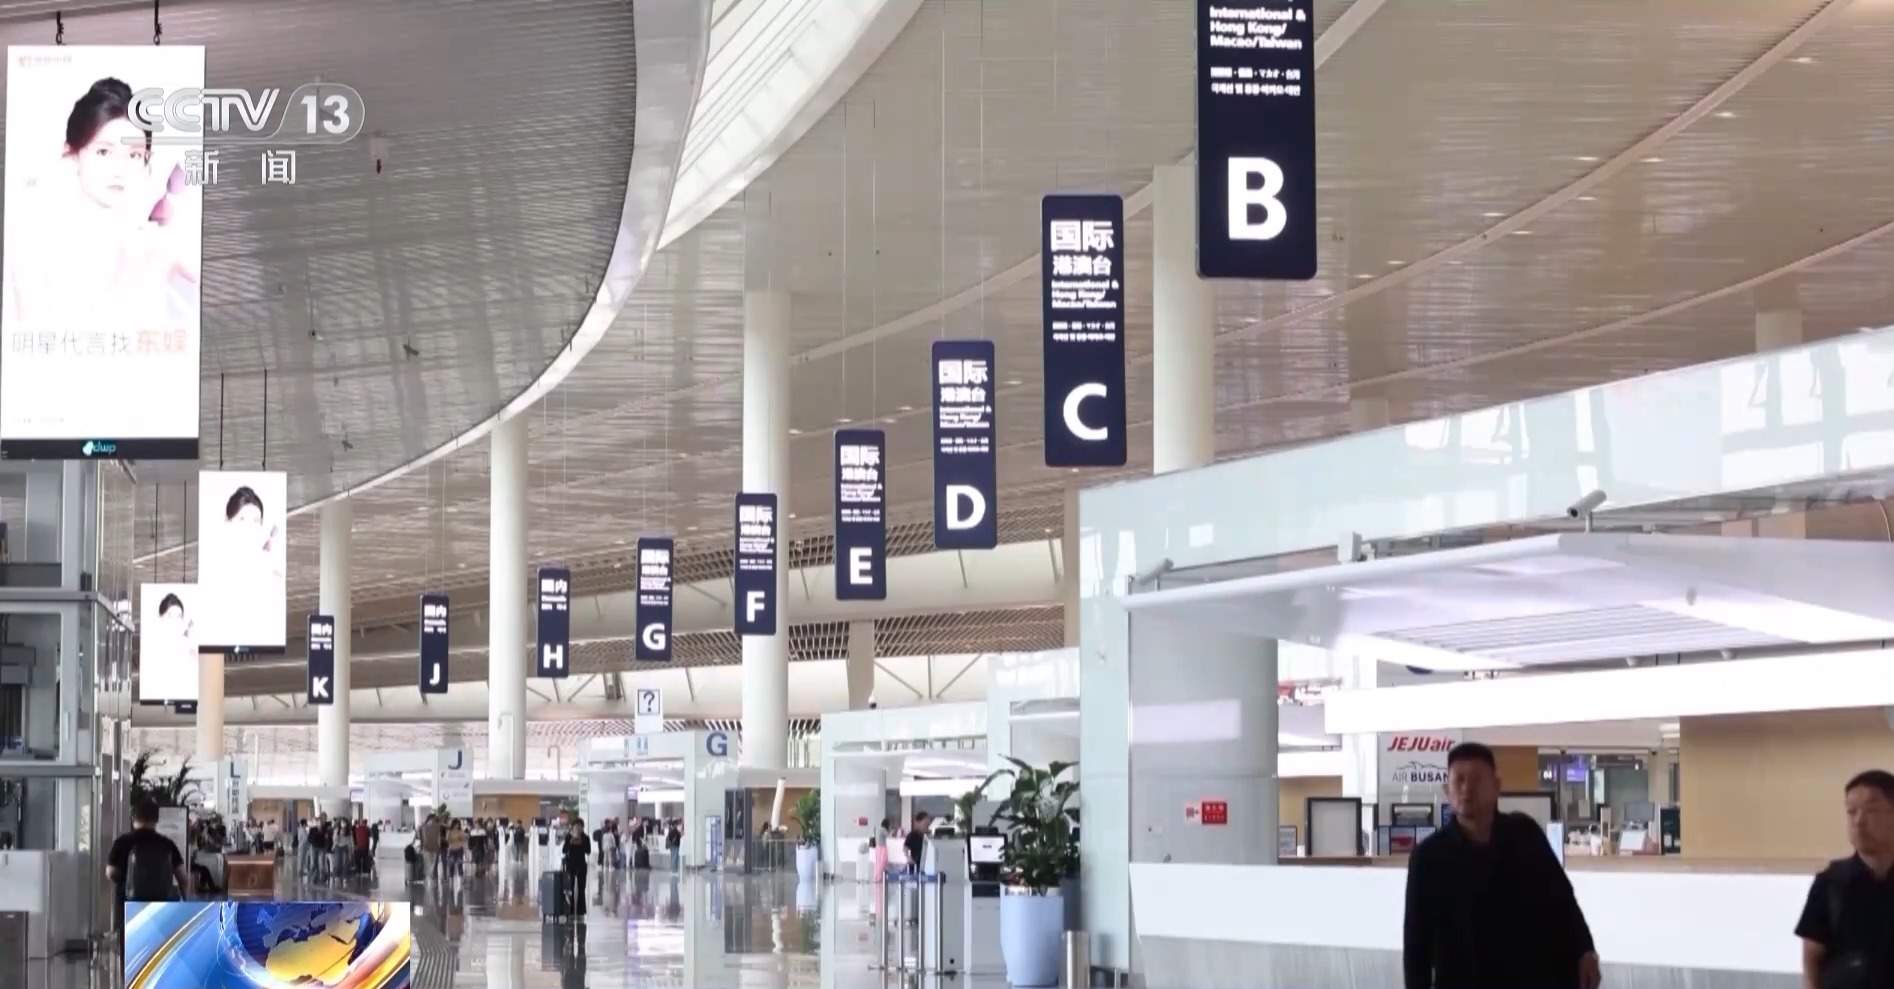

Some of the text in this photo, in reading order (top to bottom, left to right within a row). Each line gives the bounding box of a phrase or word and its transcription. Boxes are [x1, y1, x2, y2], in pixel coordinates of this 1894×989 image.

[1209, 5, 1293, 21] International
[1210, 20, 1246, 36] Hong
[1228, 157, 1287, 240] B
[1050, 220, 1115, 253] 国际
[1063, 383, 1109, 441] C
[946, 485, 986, 530] D
[849, 547, 873, 585] E
[746, 590, 766, 623] F
[642, 622, 667, 651] G
[543, 644, 564, 669] H
[312, 676, 329, 698] K
[429, 662, 441, 686] J
[705, 732, 728, 758] G
[447, 750, 463, 770] J
